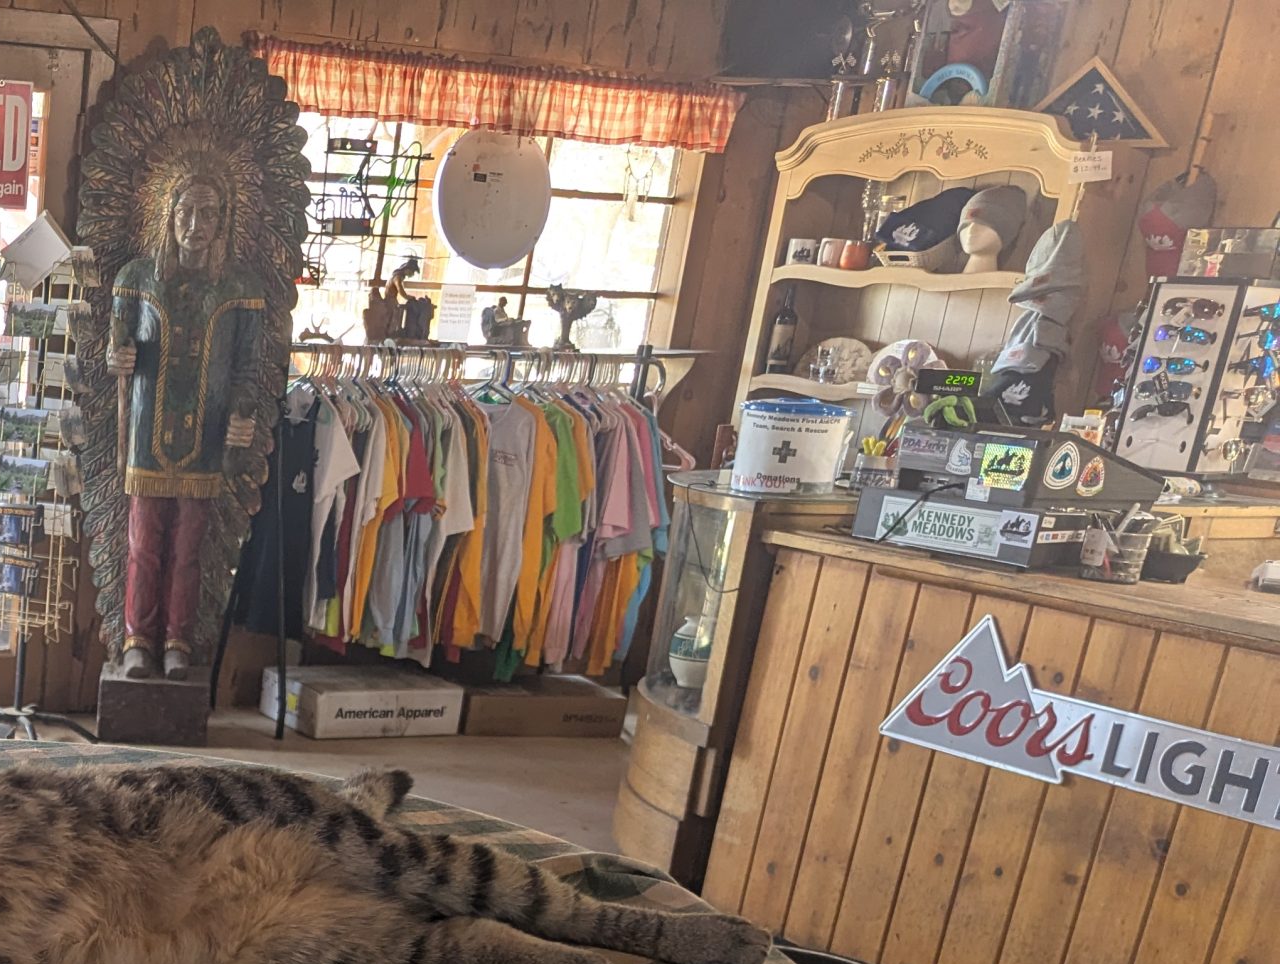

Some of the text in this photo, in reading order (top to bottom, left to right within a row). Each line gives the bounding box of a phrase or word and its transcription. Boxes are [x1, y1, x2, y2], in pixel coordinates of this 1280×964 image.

[752, 422, 769, 431] Team,
[771, 425, 795, 433] Search
[768, 415, 800, 424] Meadows
[801, 417, 818, 425] First
[756, 473, 801, 485] Donations
[917, 509, 975, 528] KENNEDY
[910, 520, 976, 542] MEADOWS
[334, 705, 447, 721] American Apparel
[904, 656, 1280, 823] Coors LIGH
